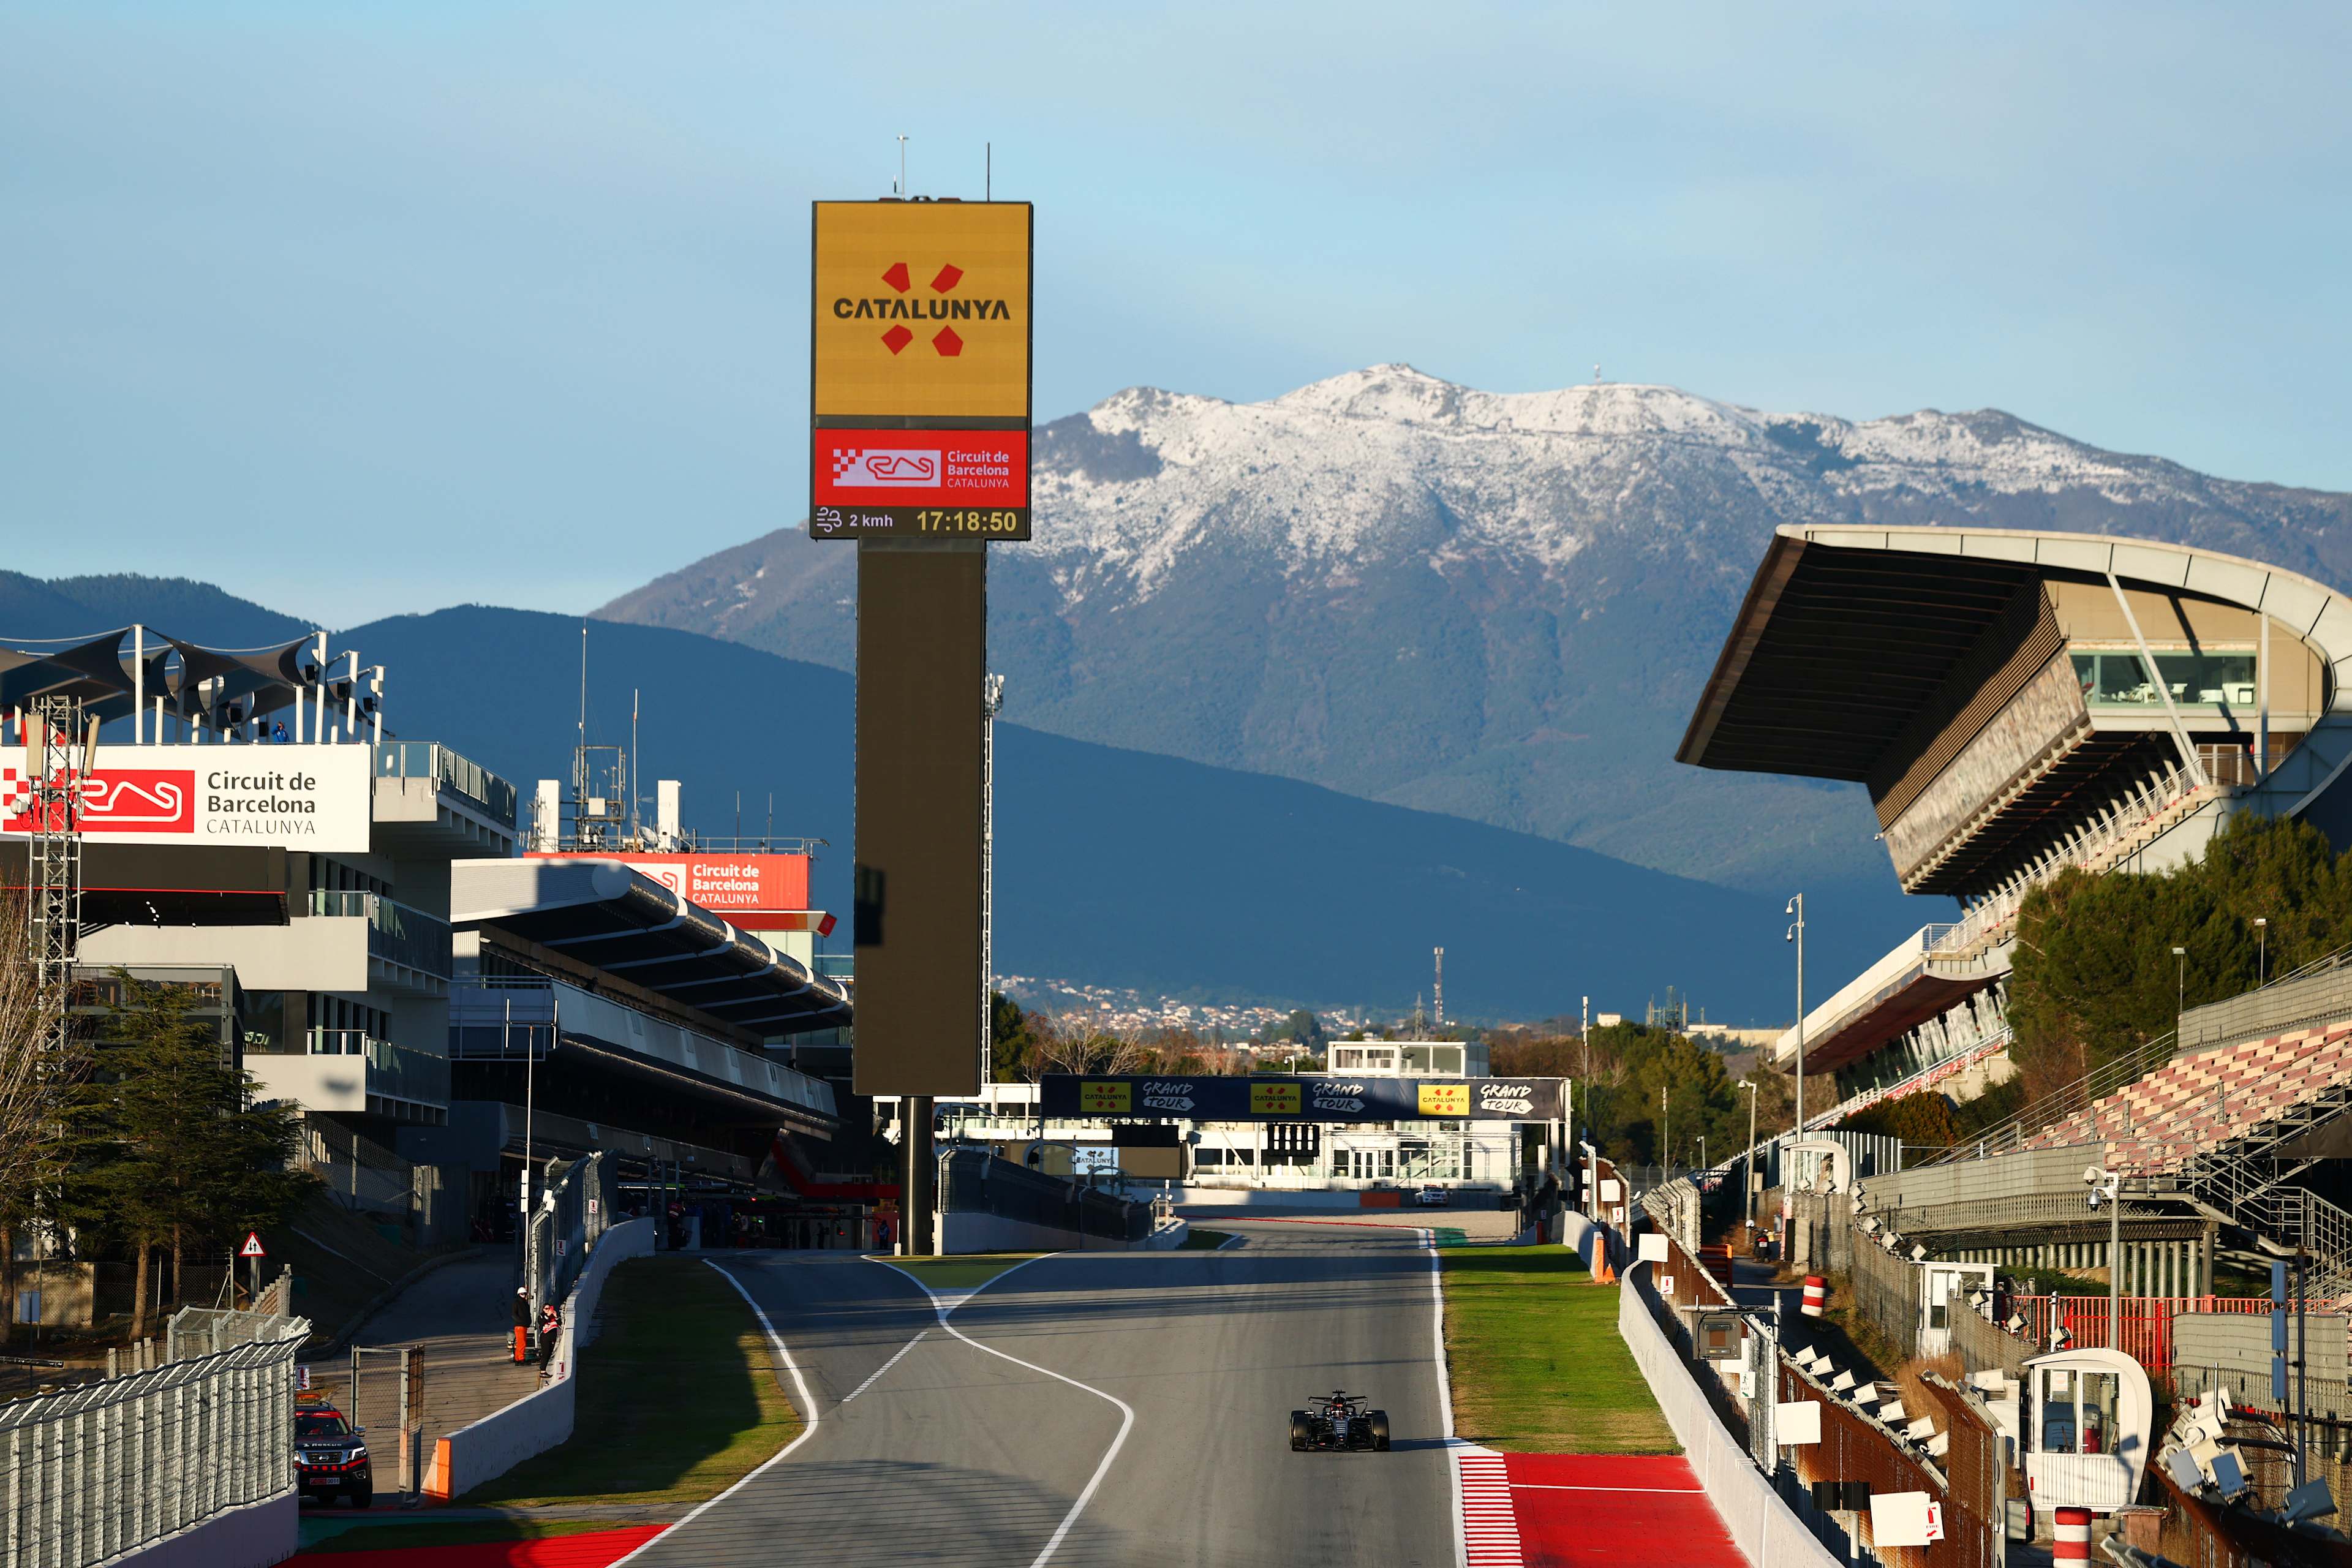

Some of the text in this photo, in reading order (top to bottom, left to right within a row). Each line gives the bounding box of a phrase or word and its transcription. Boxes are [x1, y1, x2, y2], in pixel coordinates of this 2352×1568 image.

[834, 298, 1011, 320] CATALUNYA
[948, 451, 1009, 463] Circuit de
[948, 464, 1009, 476] Barcelona
[947, 478, 1009, 488] CATALUNYA
[850, 514, 893, 527] 2 kmh
[917, 511, 1017, 532] 17:18:50
[208, 771, 316, 790] Circuit de
[208, 795, 315, 813] Barcelona
[207, 819, 315, 834] CATALUNYA
[693, 864, 760, 878] Circuit de
[693, 878, 760, 891] Barcelona
[692, 894, 760, 903] CATALUNYA
[1142, 1082, 1194, 1095] GRAND
[1313, 1082, 1364, 1096] GRAND
[1480, 1084, 1532, 1098] GRAND
[1148, 1098, 1187, 1109] TOUR
[1318, 1098, 1357, 1110] TOUR
[1487, 1100, 1525, 1112] TOUR
